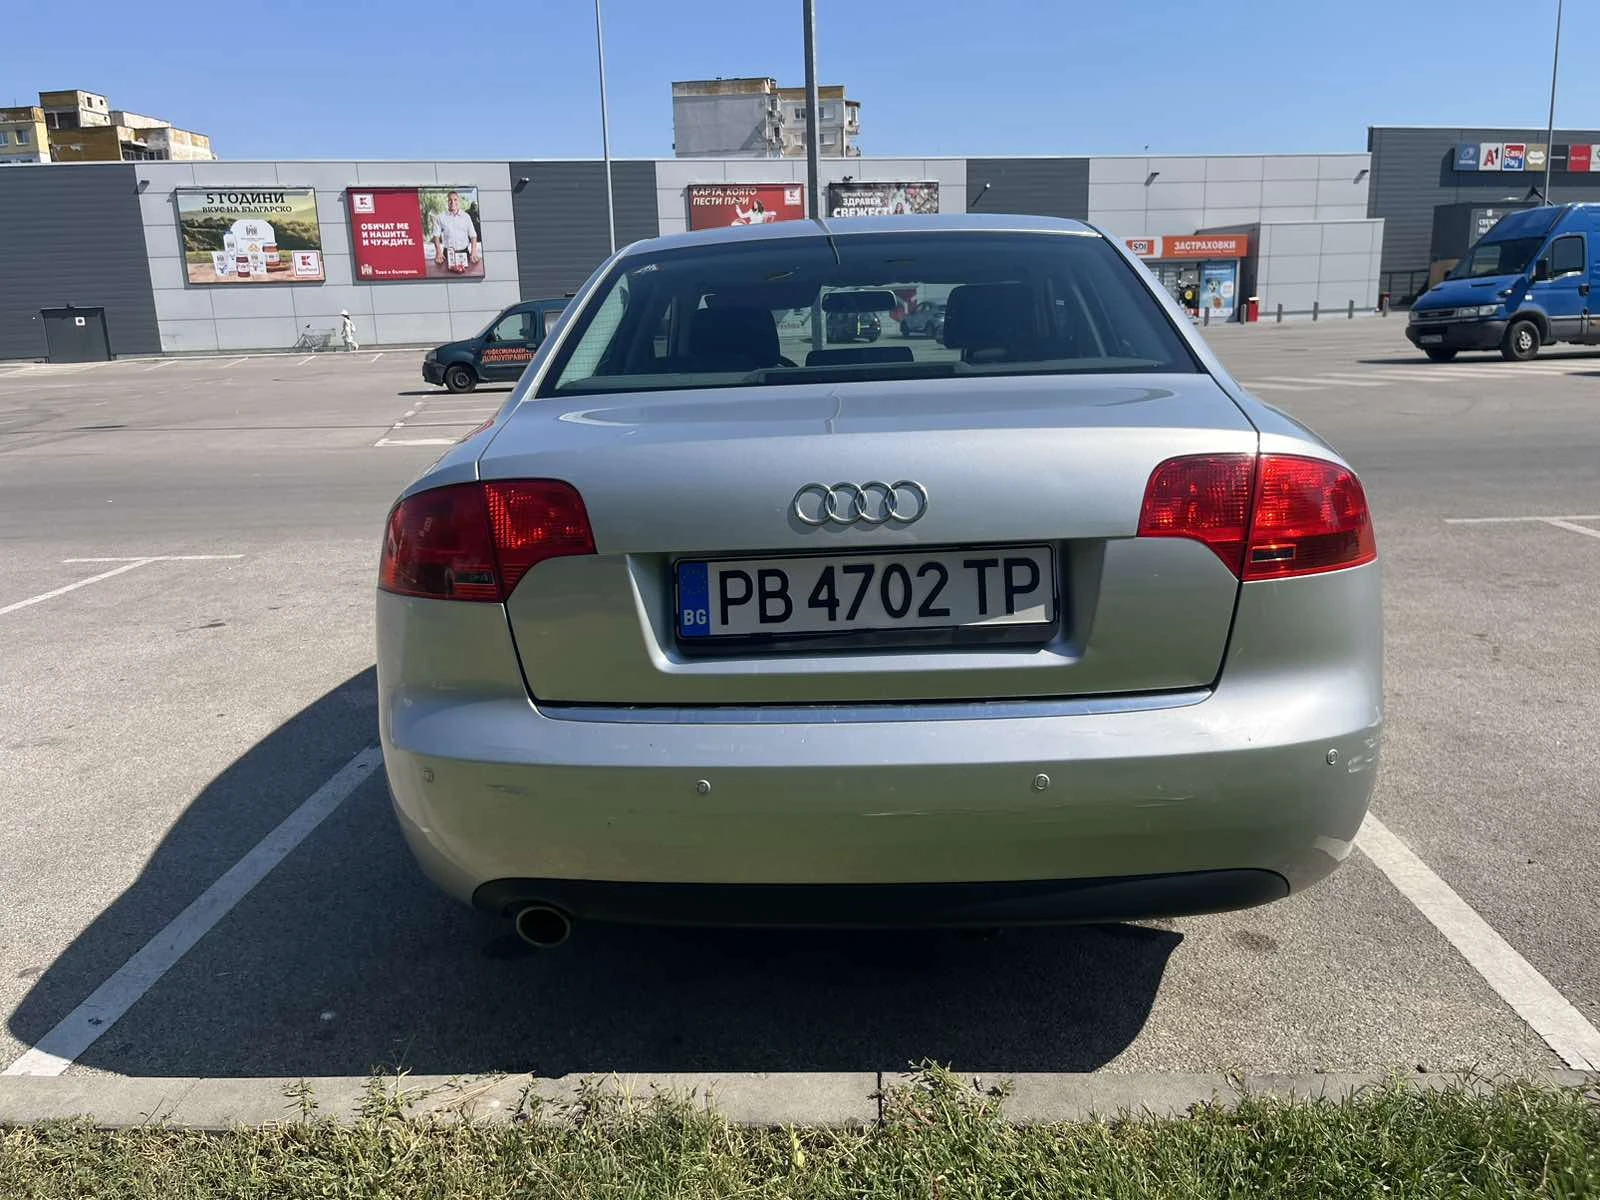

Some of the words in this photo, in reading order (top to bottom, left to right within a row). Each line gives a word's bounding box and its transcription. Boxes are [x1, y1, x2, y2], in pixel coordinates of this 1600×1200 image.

[1484, 147, 1500, 166] A1
[1505, 149, 1523, 159] Easy
[1504, 159, 1519, 168] Pay
[207, 193, 215, 204] 5
[218, 192, 285, 205] ГОДИНИ
[692, 197, 723, 205] ПЕСТИ
[241, 205, 293, 213] БЪЛГАРСКО
[1174, 240, 1236, 250] ЗАСТРАХОВКИ
[718, 568, 793, 625] PB
[807, 561, 951, 621] 4702
[963, 556, 1041, 616] TP
[682, 608, 707, 626] BG
